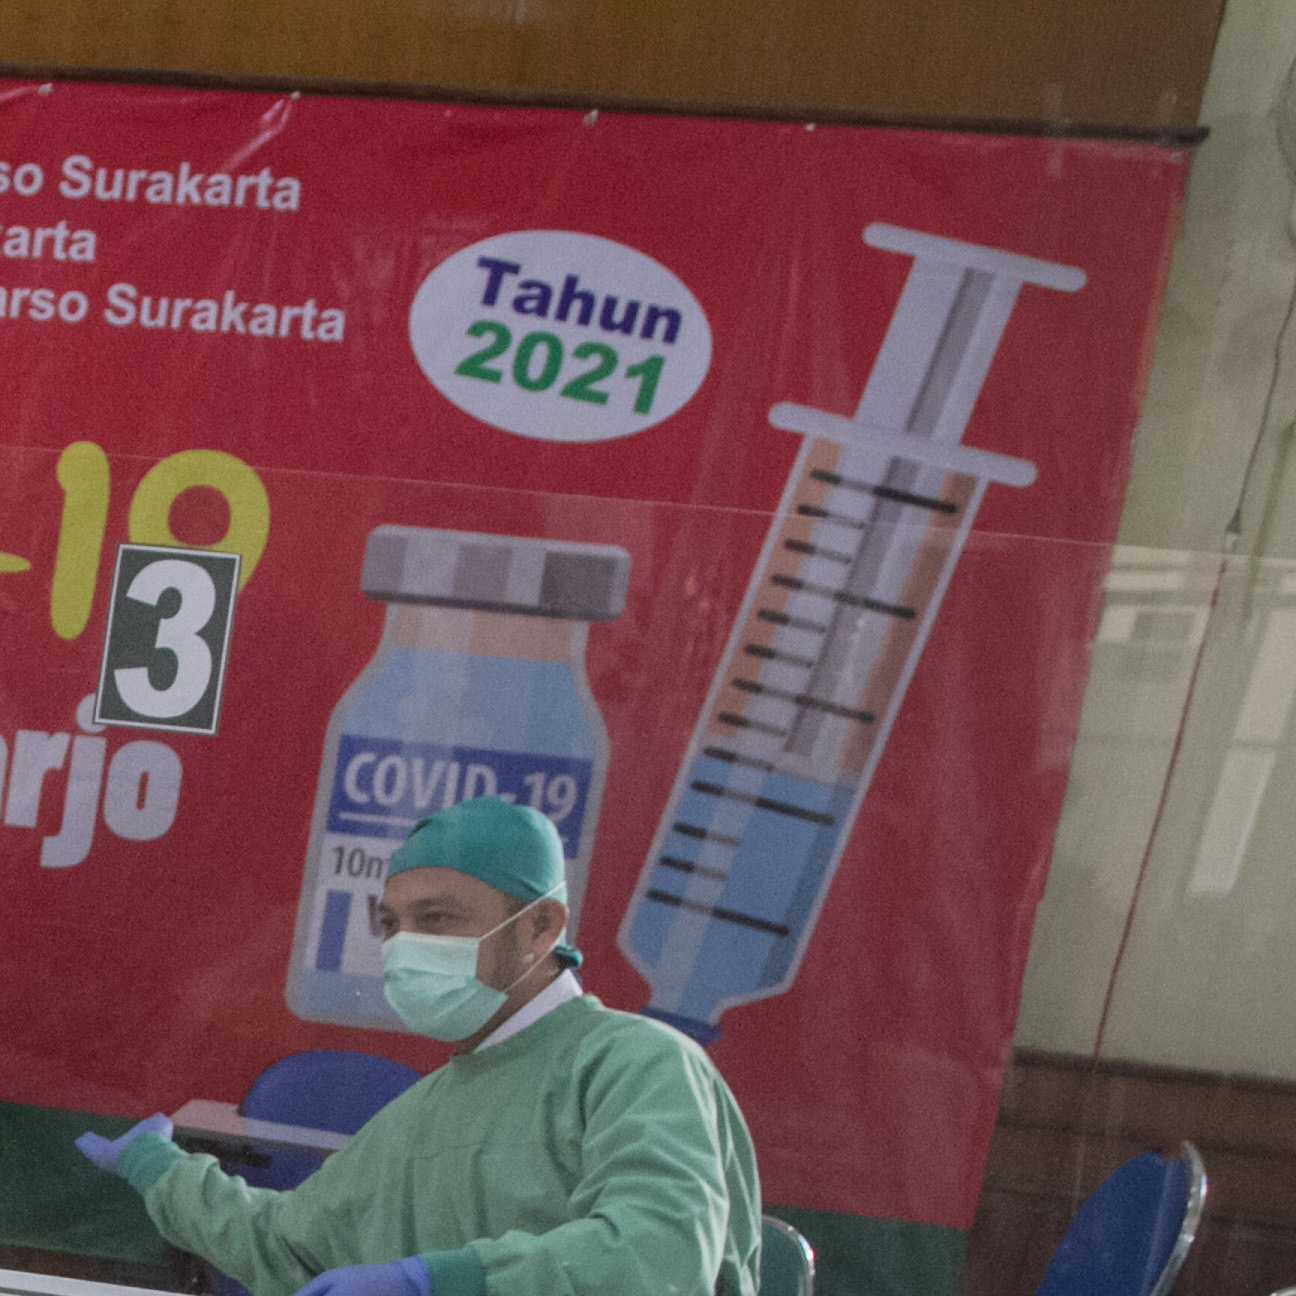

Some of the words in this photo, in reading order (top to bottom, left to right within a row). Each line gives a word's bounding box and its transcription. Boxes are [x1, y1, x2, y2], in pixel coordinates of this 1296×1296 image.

[59, 154, 301, 211] Surakarta
[103, 282, 346, 342] Surakarta
[476, 254, 683, 345] Tahun
[452, 318, 668, 417] 2021
[113, 558, 217, 719] 3
